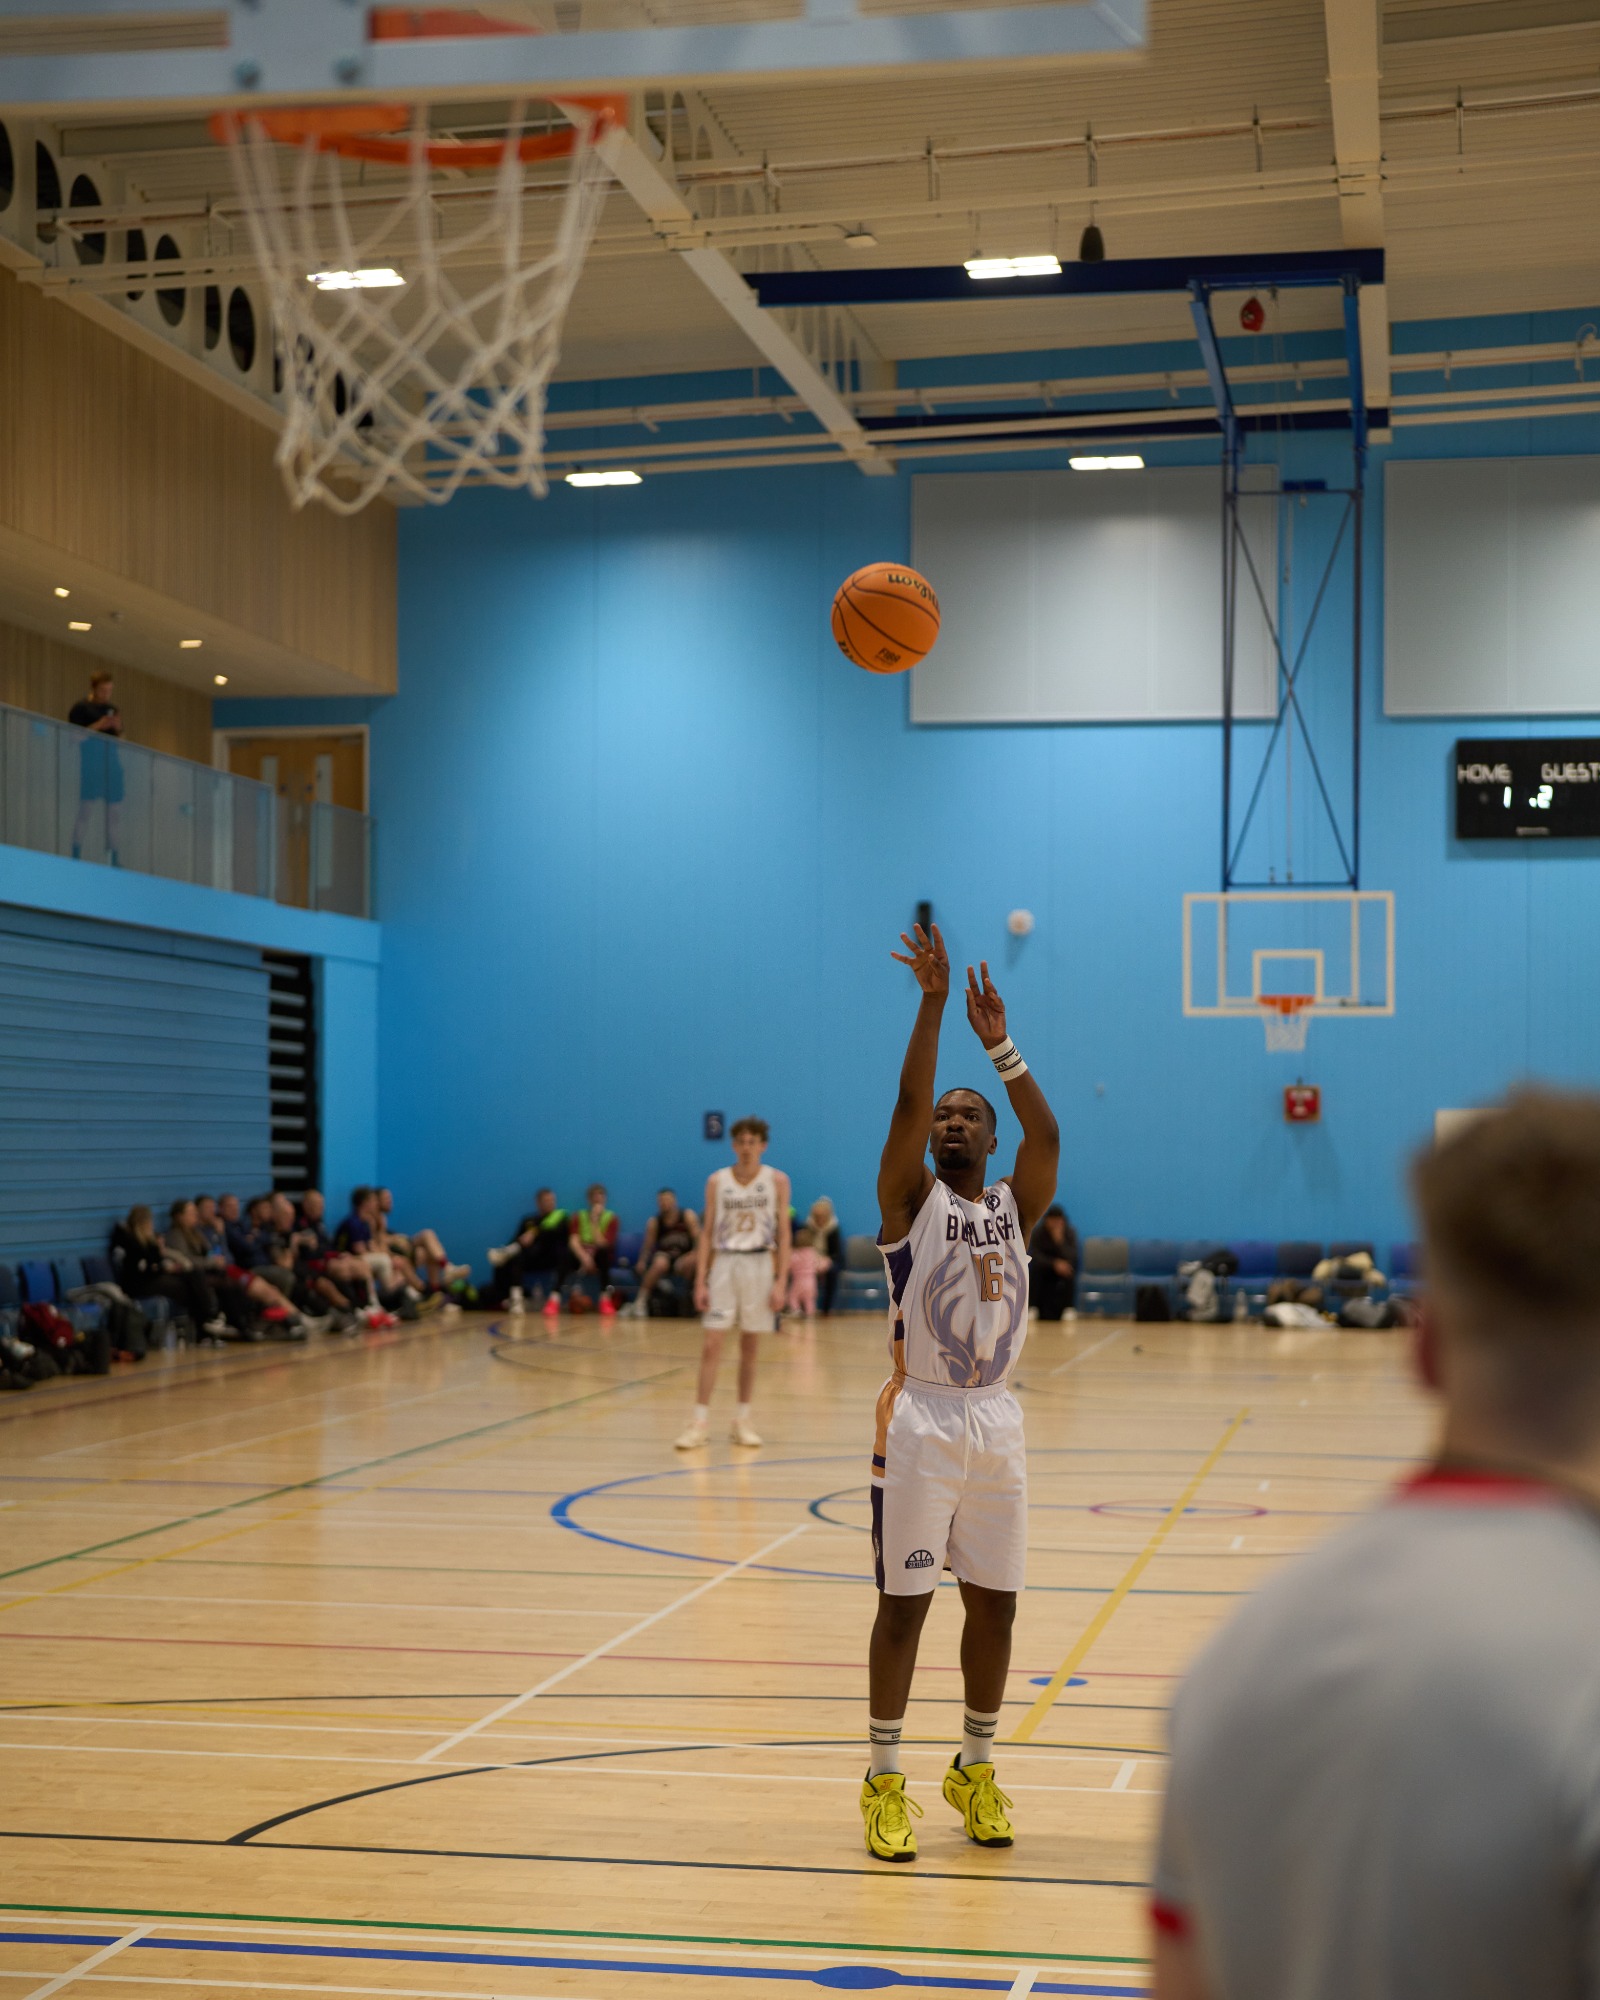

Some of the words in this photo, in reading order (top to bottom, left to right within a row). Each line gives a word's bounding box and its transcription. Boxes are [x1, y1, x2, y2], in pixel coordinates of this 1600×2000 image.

[1457, 763, 1512, 784] HOME
[1541, 762, 1600, 784] GUEST
[972, 1252, 1004, 1302] 16
